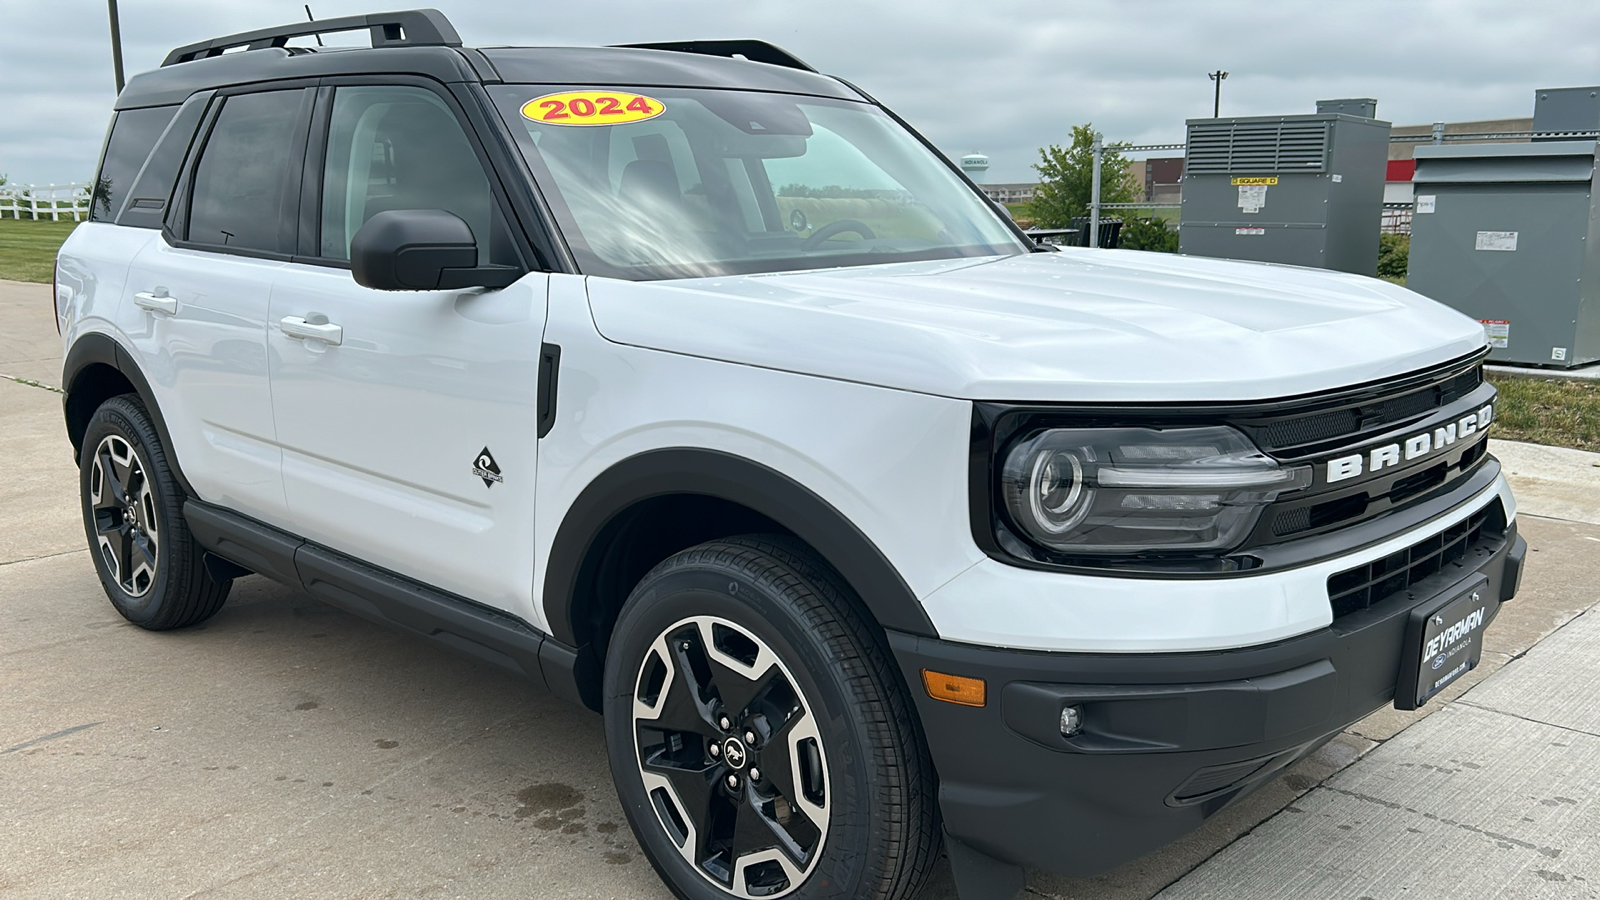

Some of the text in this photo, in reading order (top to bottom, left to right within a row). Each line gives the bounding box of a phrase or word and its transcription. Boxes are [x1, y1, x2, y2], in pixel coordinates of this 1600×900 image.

[539, 97, 653, 120] 2024
[1326, 404, 1493, 483] BRONCO
[1423, 606, 1485, 663] DEYARMAN
[1446, 637, 1471, 659] INDIANOLA
